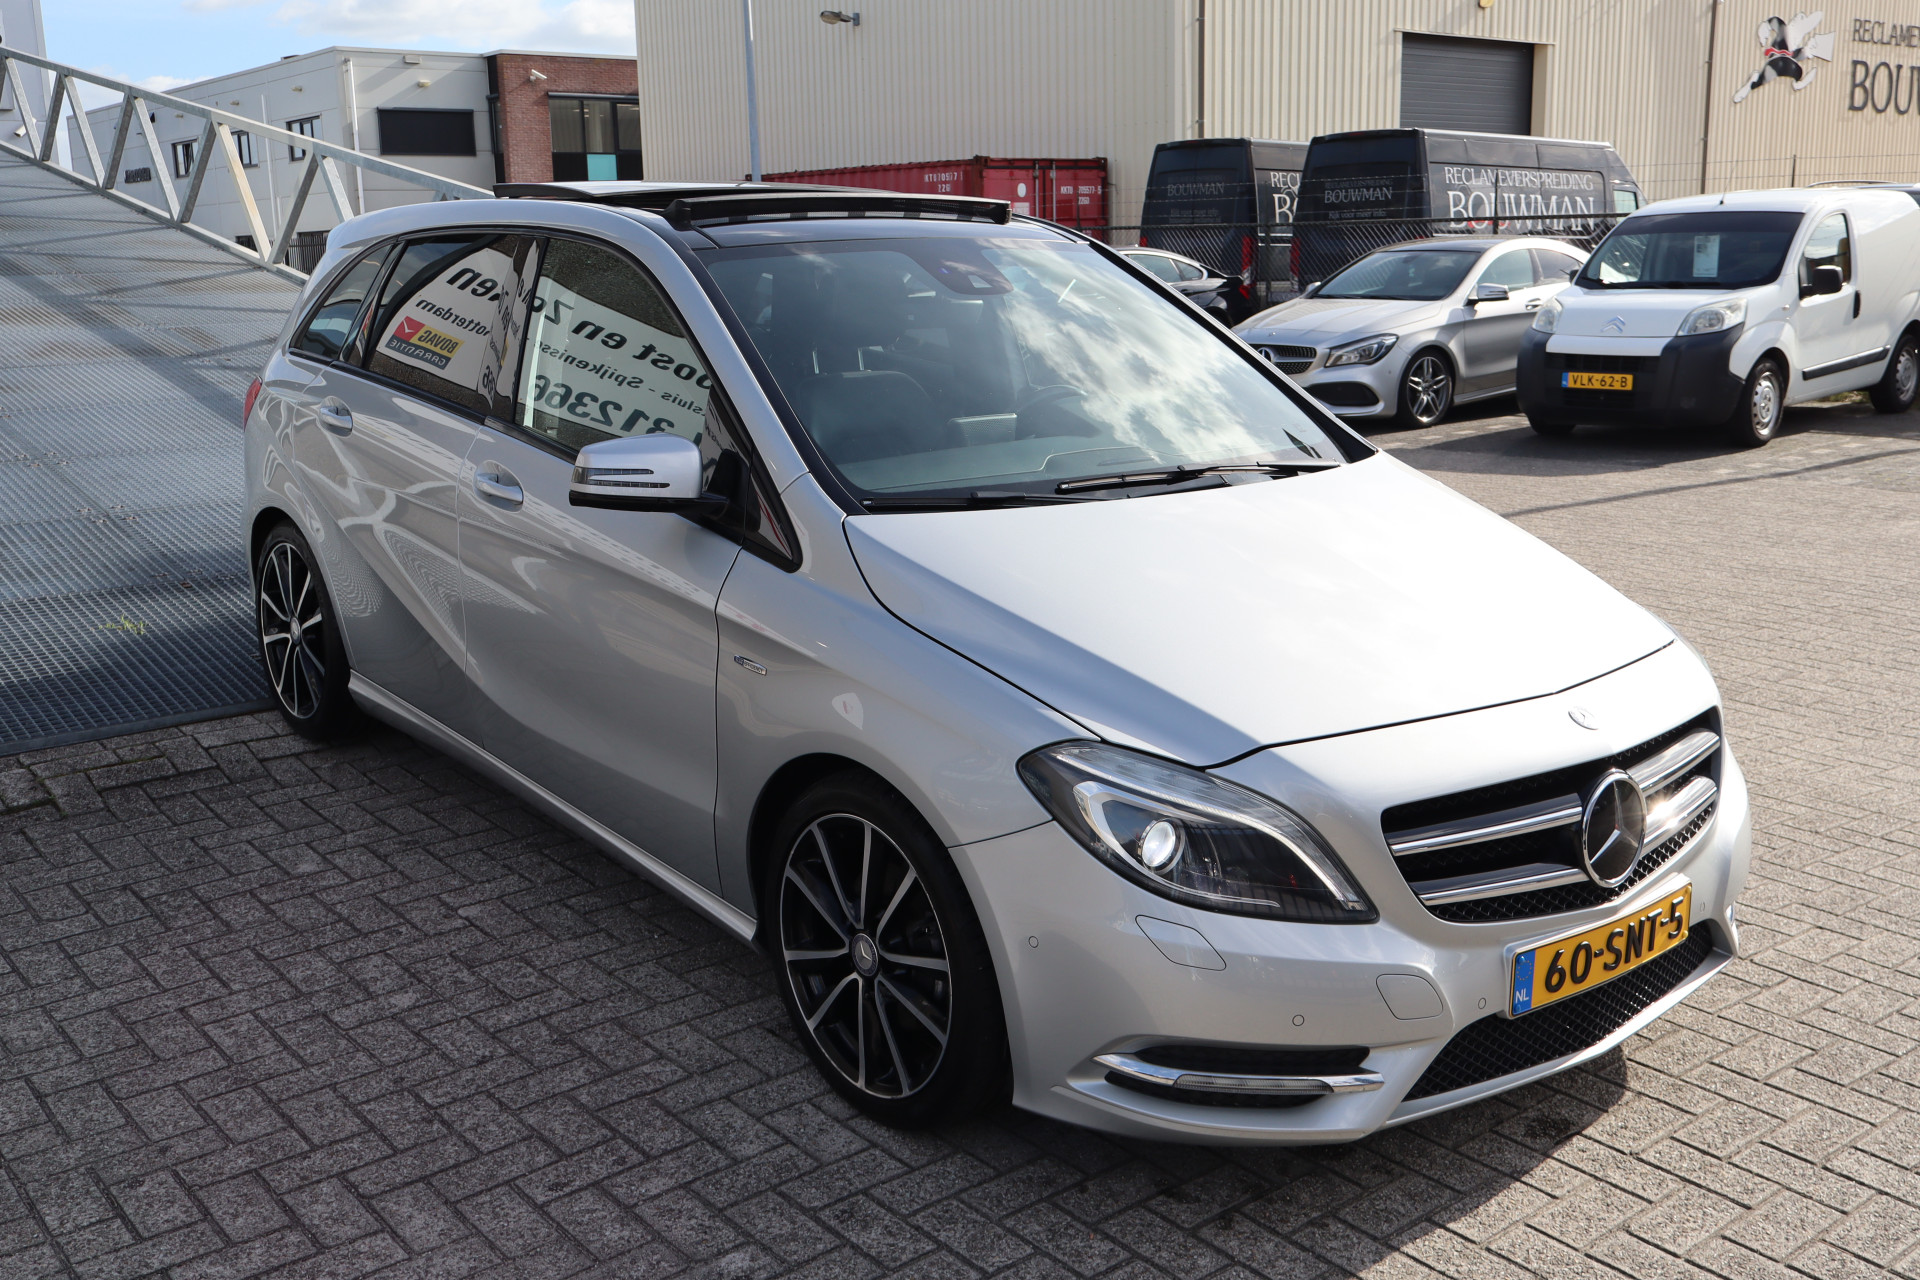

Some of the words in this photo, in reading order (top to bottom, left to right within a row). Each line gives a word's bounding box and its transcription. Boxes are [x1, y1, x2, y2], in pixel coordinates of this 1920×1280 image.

[1848, 60, 1920, 115] BOU
[1444, 167, 1594, 191] RECLAMEVERSPREIDING
[1167, 182, 1225, 197] BOUWMAN
[1324, 187, 1392, 204] BOUWMAN
[1447, 190, 1594, 231] BOUWMAN
[1572, 374, 1628, 388] VLK-62-B
[1545, 896, 1684, 993] 60-SNT-5
[1515, 988, 1530, 1003] NL
